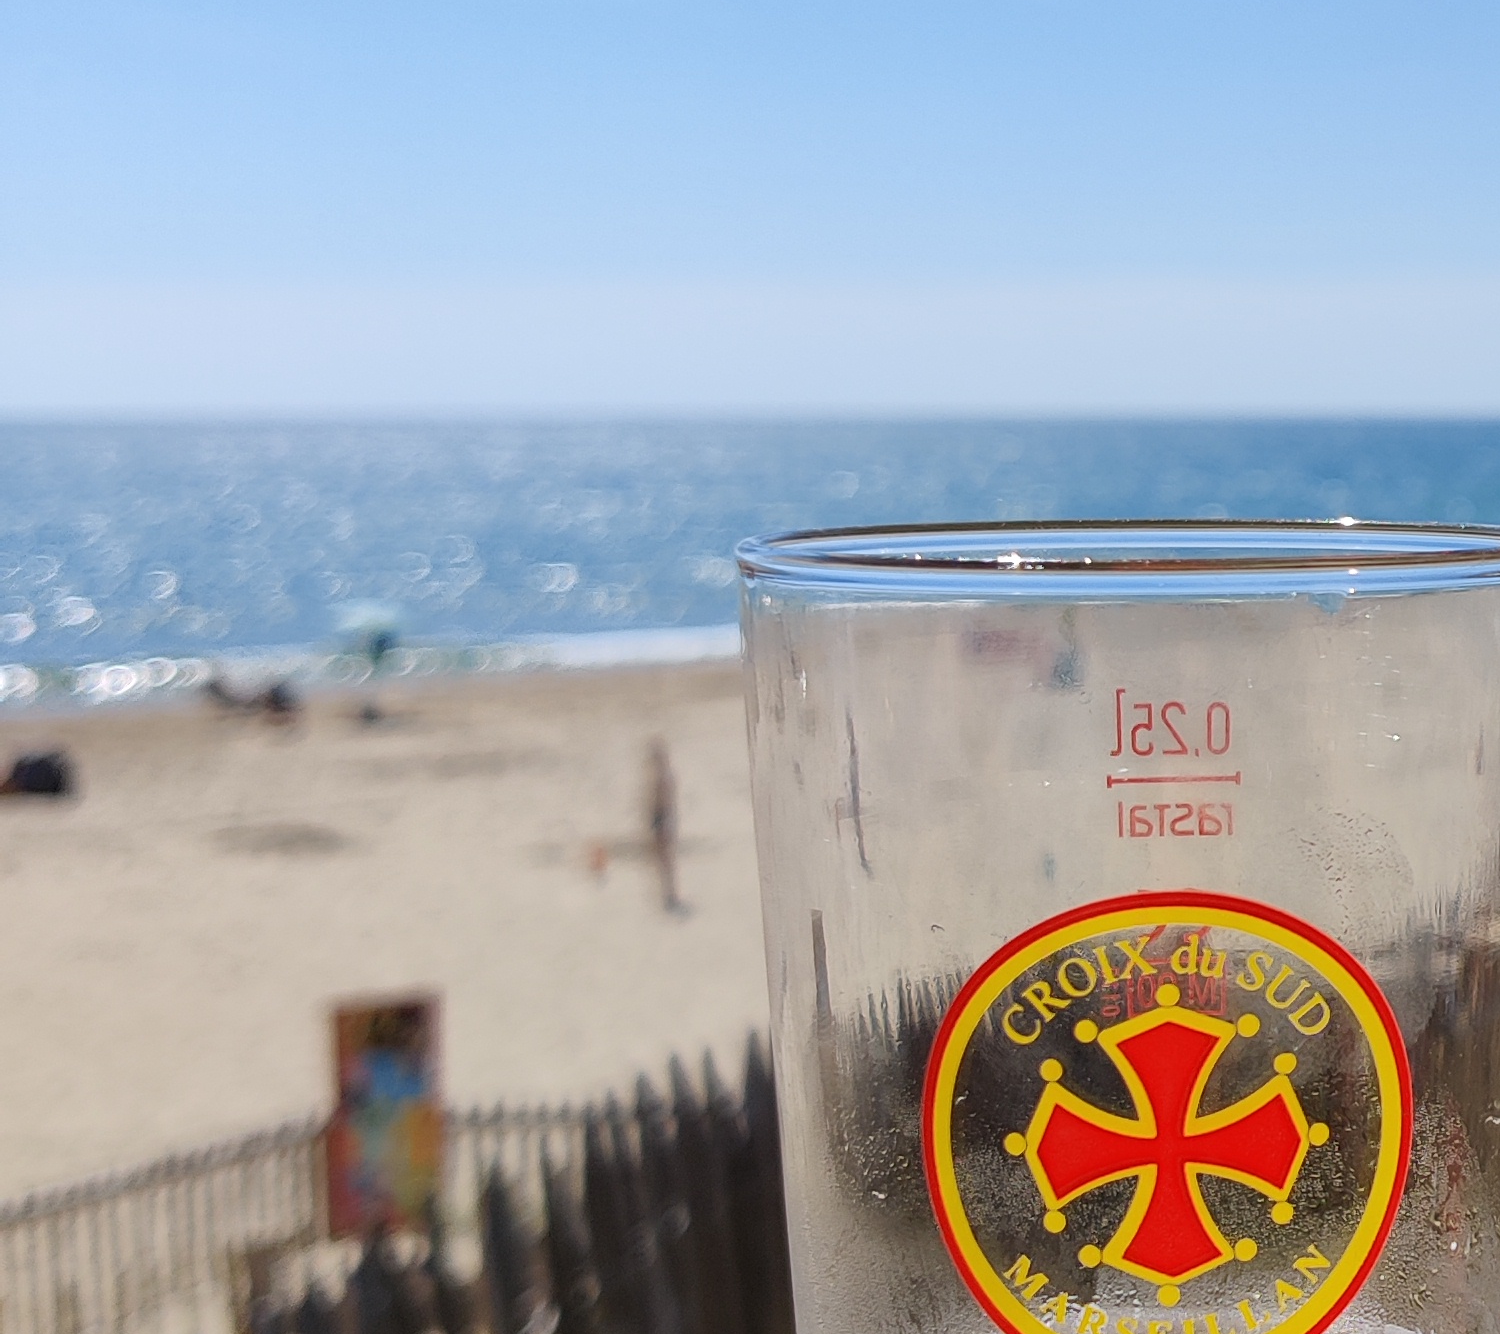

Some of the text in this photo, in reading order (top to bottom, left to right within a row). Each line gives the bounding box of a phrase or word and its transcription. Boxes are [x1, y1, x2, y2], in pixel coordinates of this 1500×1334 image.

[1002, 934, 1157, 1046] CROIX
[1170, 933, 1228, 978] du
[1235, 951, 1331, 1036] SUD
